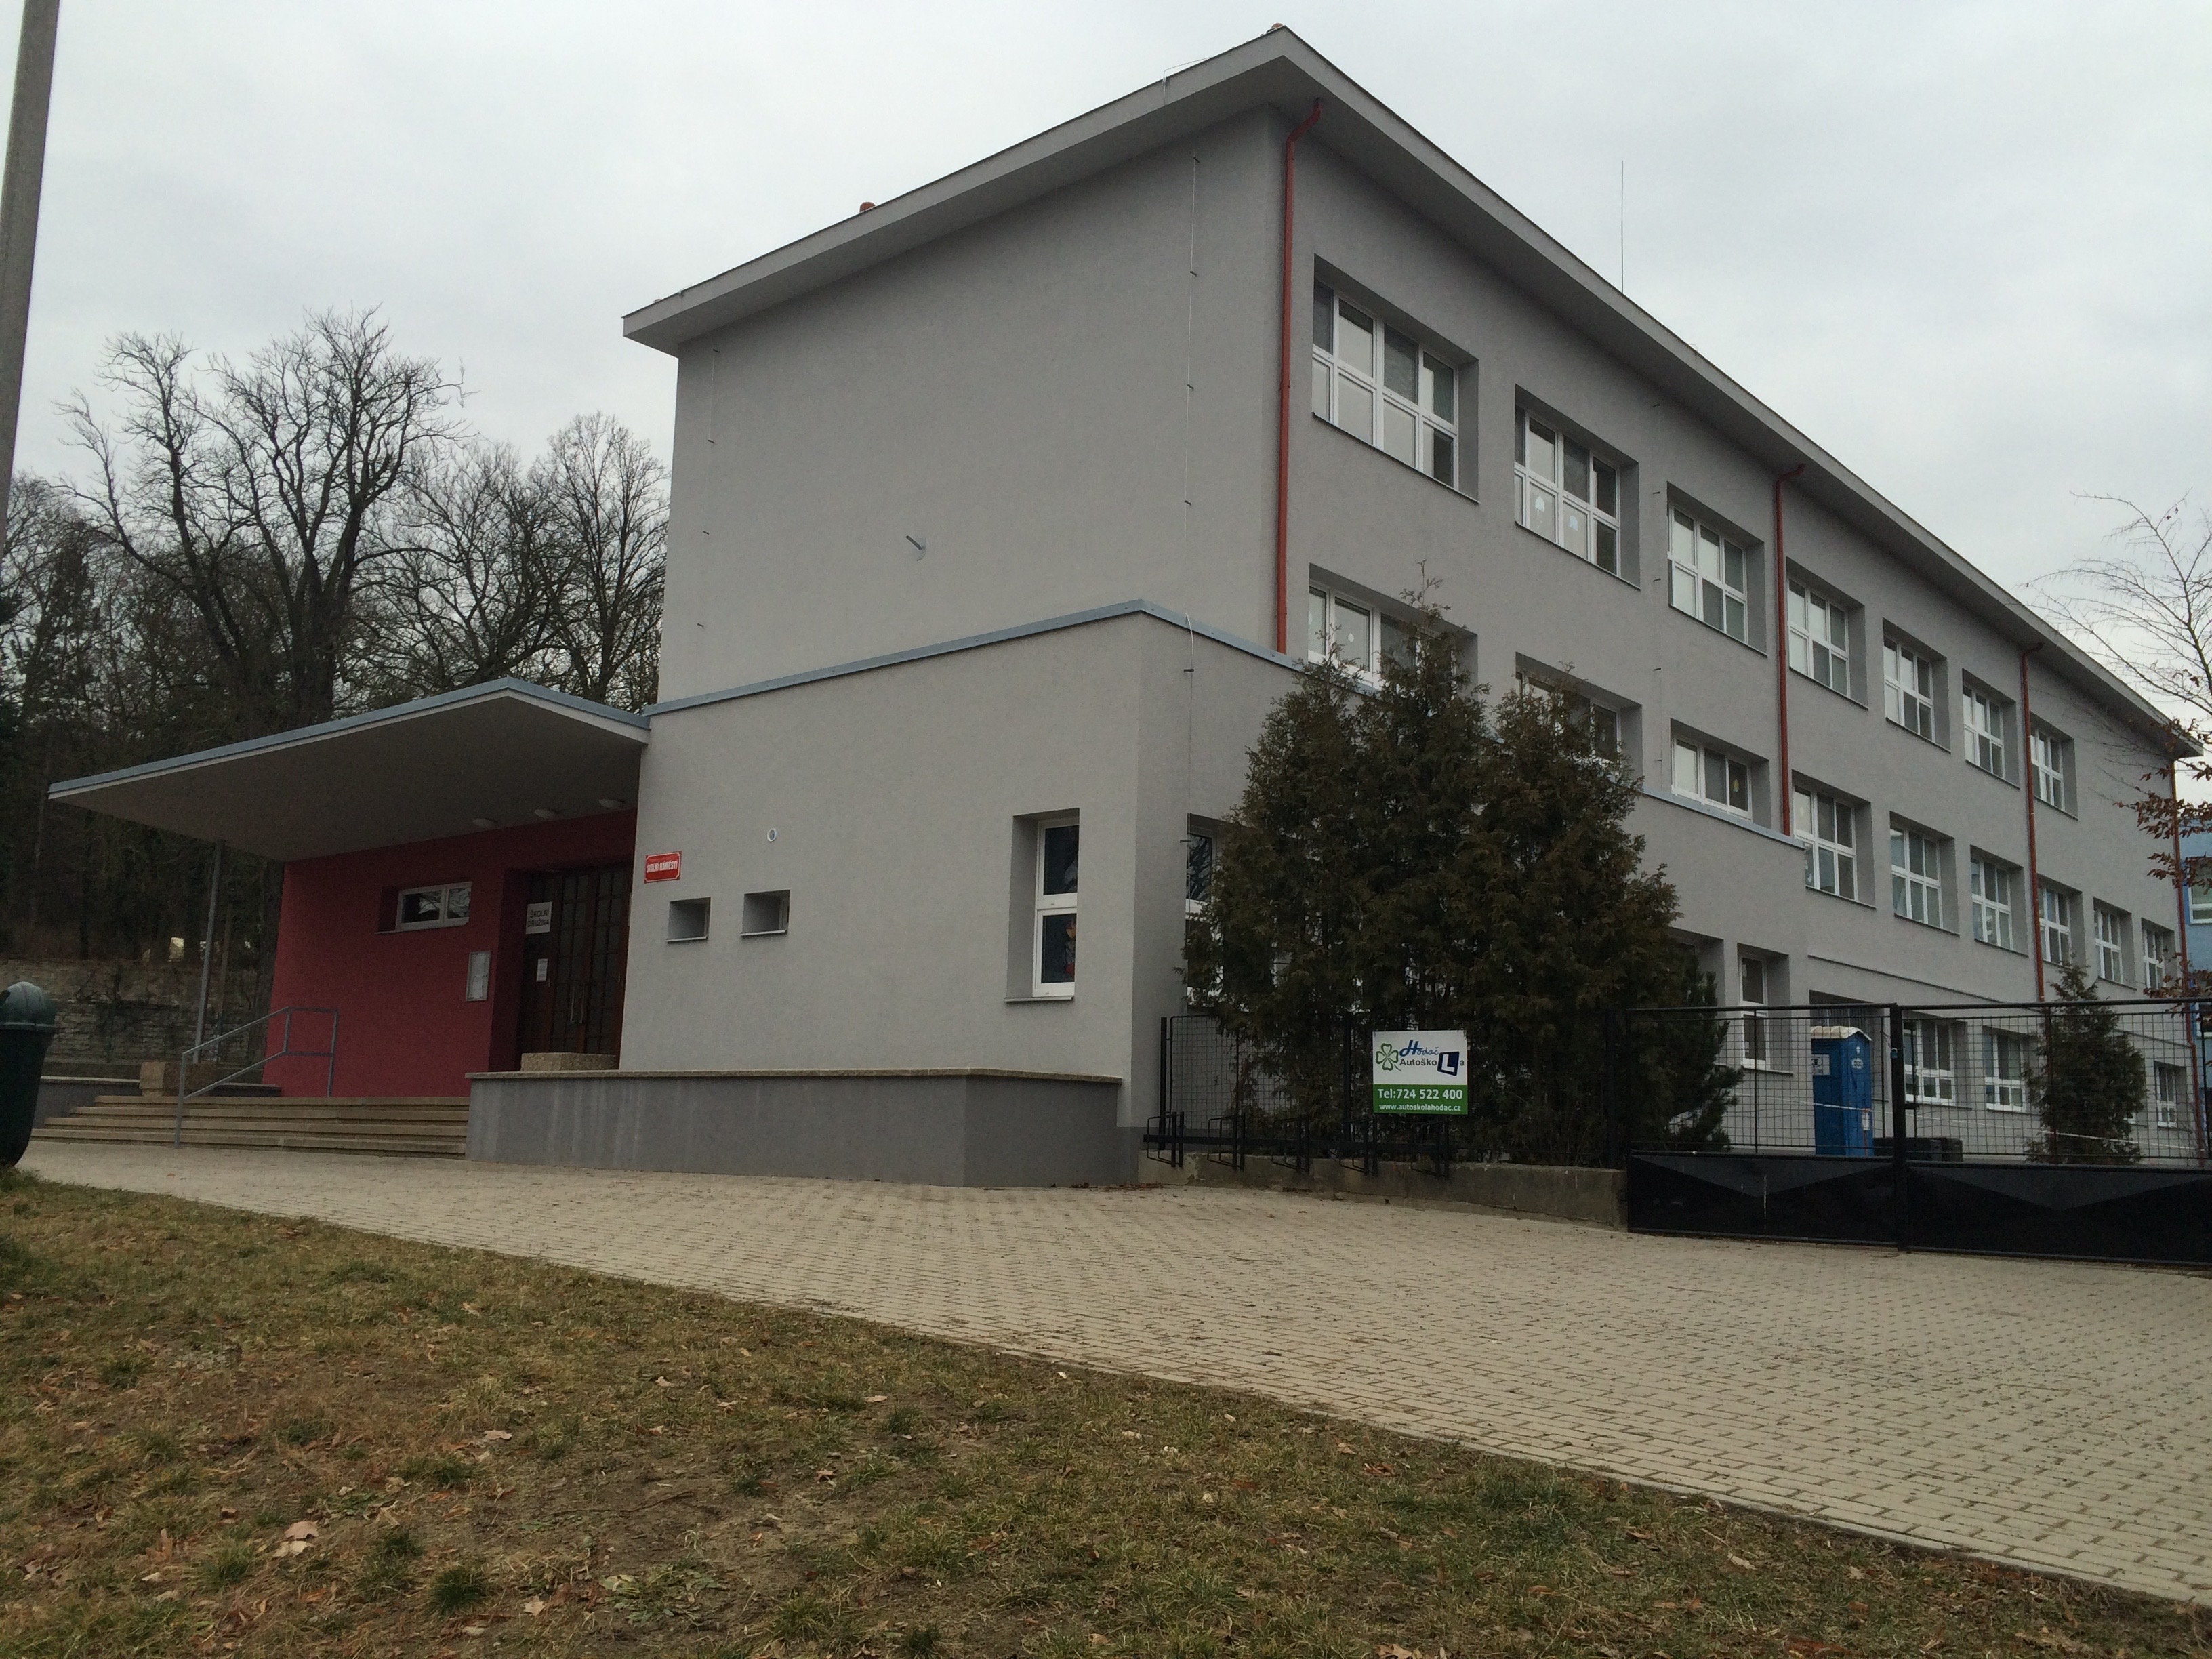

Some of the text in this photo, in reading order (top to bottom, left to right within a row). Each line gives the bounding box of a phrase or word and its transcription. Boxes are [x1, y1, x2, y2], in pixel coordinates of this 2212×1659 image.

[1399, 1039, 1439, 1057] Hodač
[1378, 1088, 1462, 1099] Tel:724 522 400
[1379, 1103, 1461, 1111] www.autoskolahodac.cz
